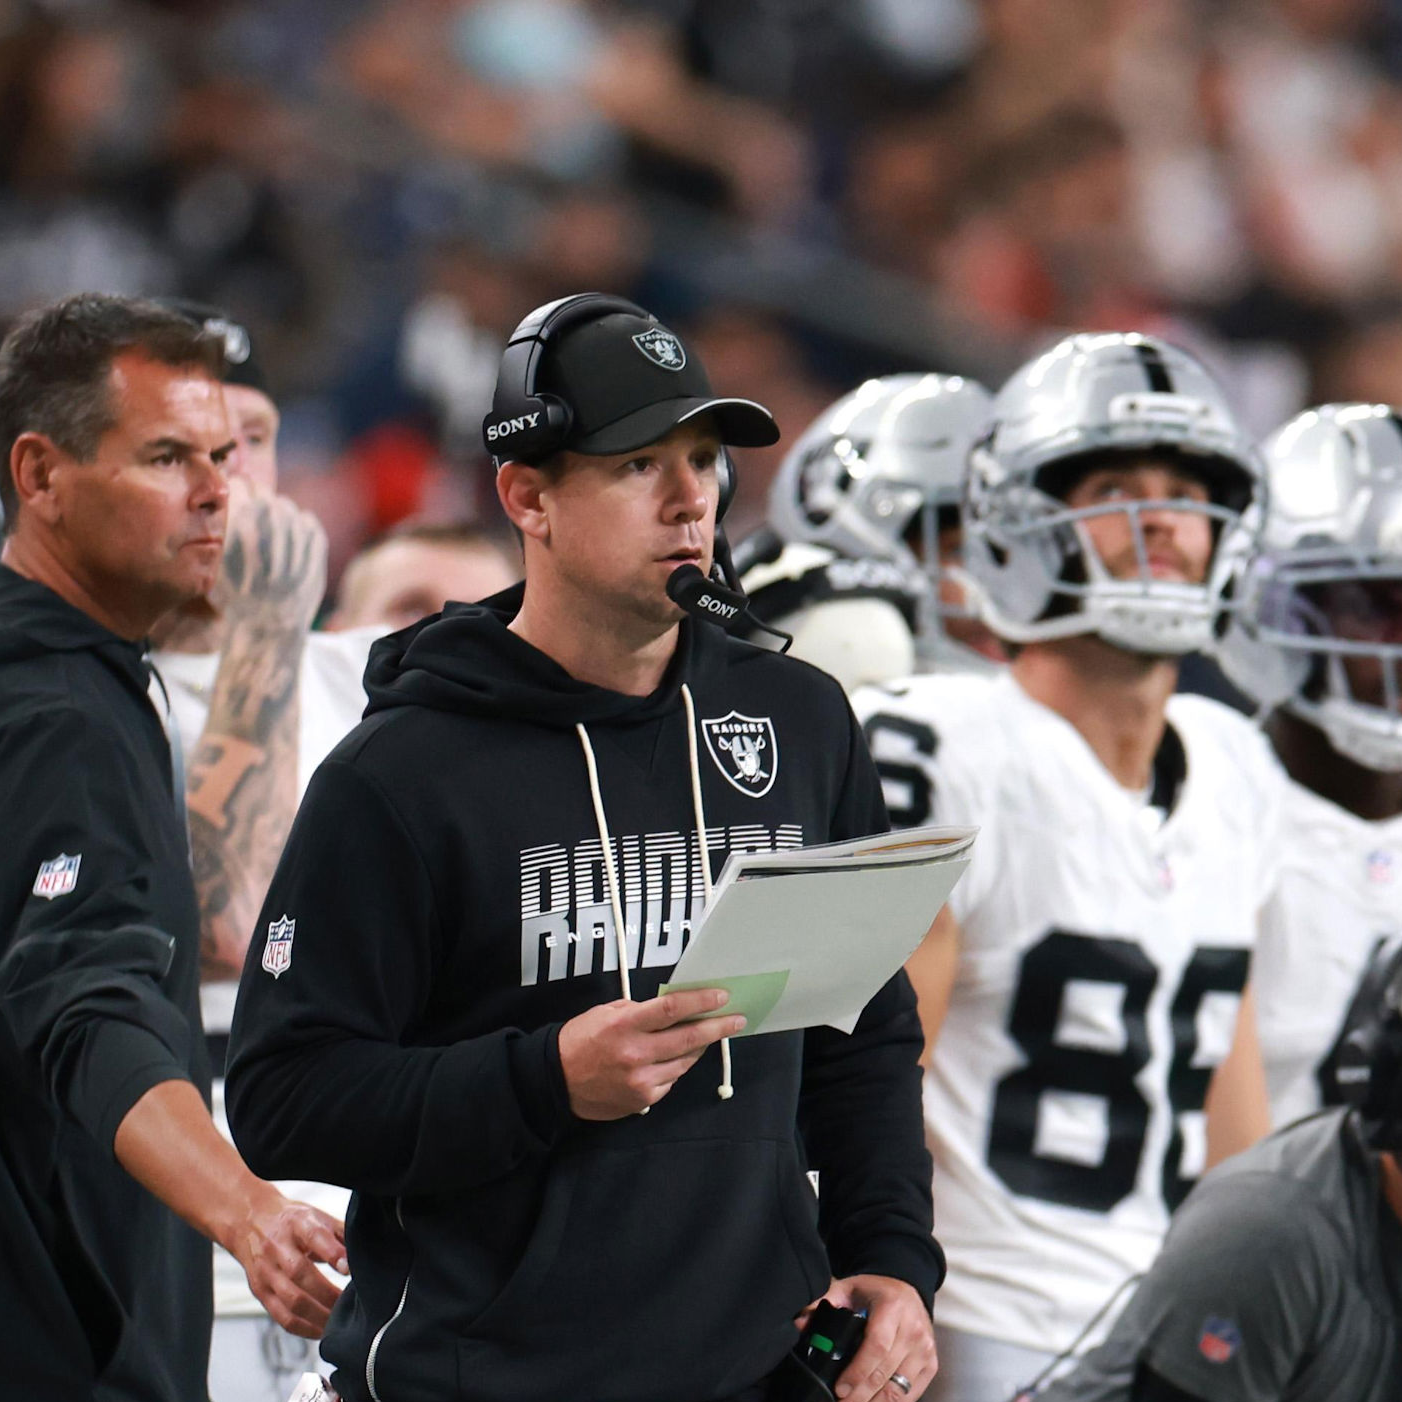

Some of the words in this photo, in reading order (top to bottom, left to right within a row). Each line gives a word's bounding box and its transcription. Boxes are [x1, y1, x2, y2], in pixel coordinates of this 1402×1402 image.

[487, 411, 540, 441] SONY
[697, 594, 739, 619] SONY
[711, 723, 765, 734] RAIDERS
[545, 919, 692, 949] ENGNEER
[266, 942, 289, 968] NFL
